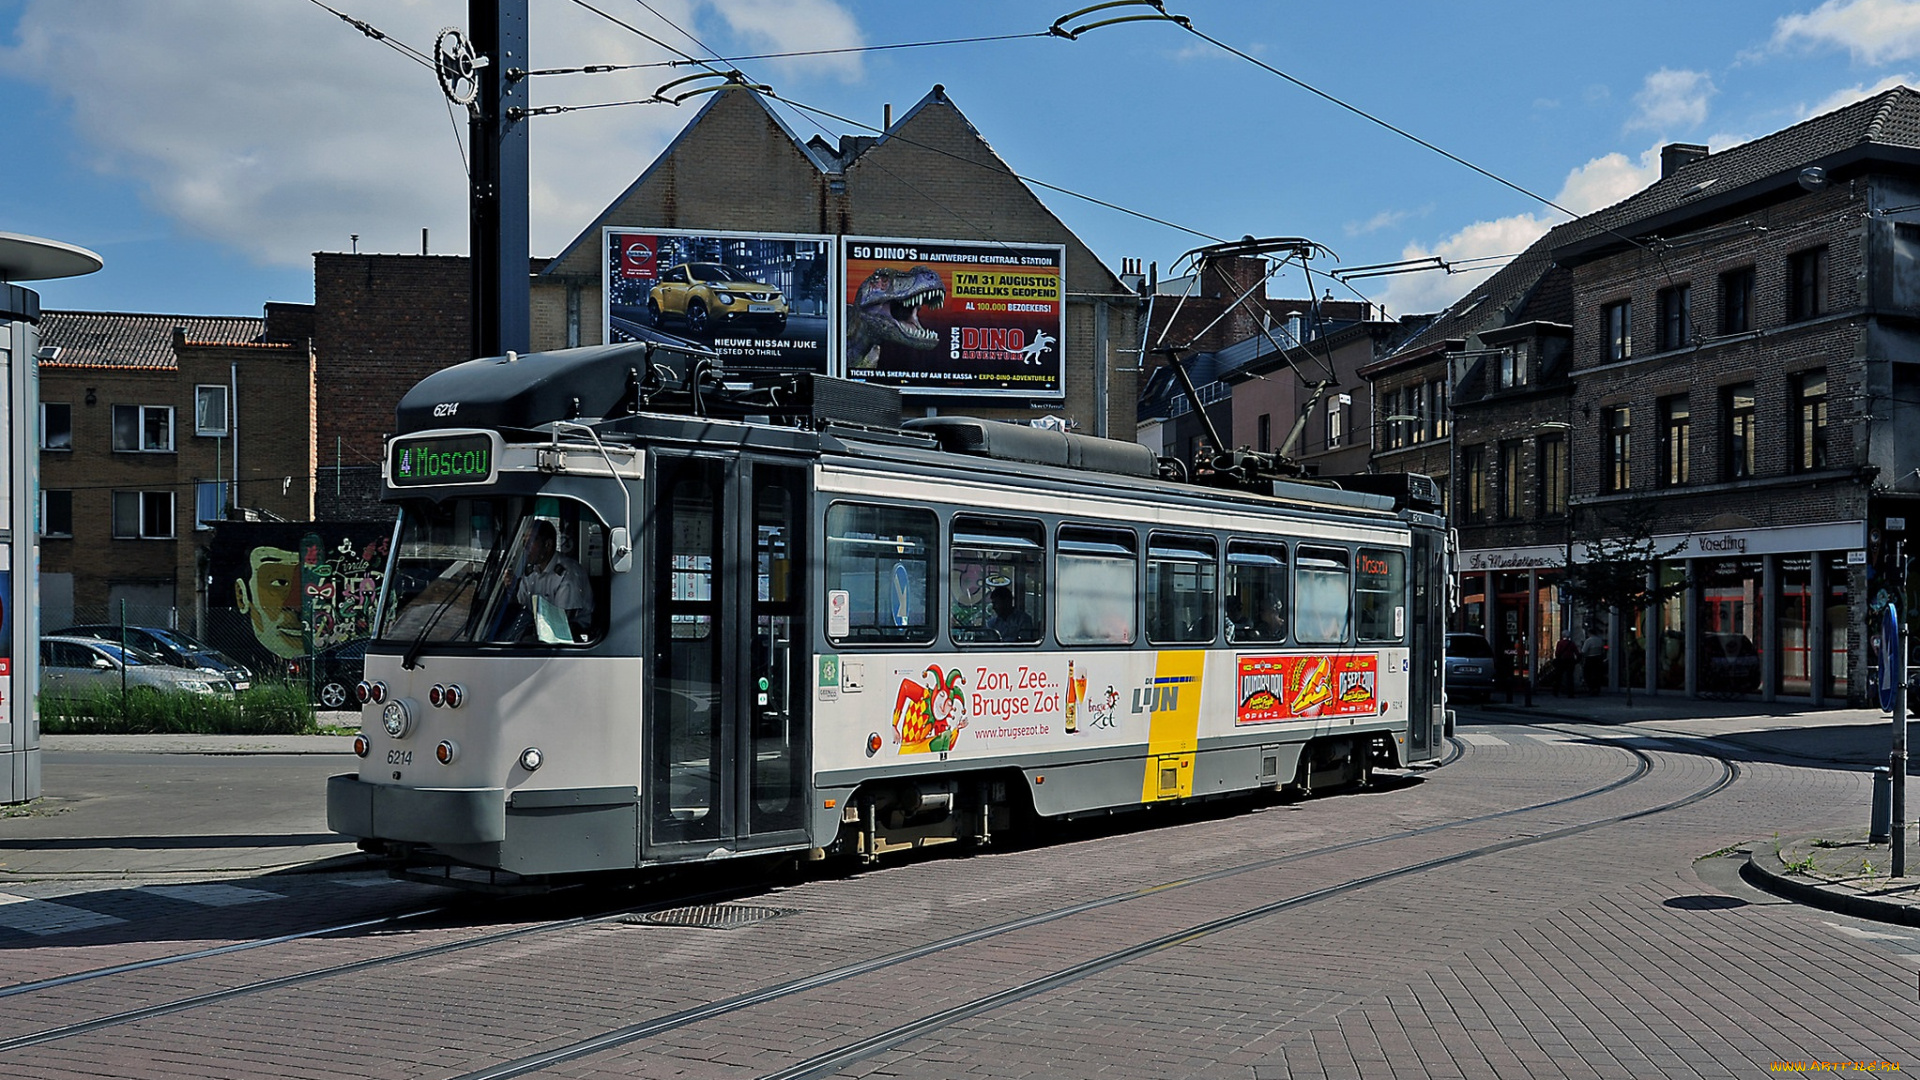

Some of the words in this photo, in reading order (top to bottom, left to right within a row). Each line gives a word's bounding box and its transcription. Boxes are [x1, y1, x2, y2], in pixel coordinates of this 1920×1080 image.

[854, 246, 871, 258] 50
[874, 247, 918, 260] DINO'S
[920, 253, 929, 261] IN
[930, 253, 978, 263] ANTWERPEN
[980, 255, 1019, 264] CENTRAAL
[1021, 257, 1052, 265] STATION
[956, 274, 978, 285] T/M
[982, 275, 995, 285] 31
[999, 276, 1056, 287] AUGUSTUS
[956, 286, 1009, 296] DAGELIJKS
[1012, 288, 1057, 298] GEOPEND
[965, 302, 975, 310] AL
[977, 303, 1006, 311] 100.000
[1007, 303, 1052, 313] BEZOEKERS!
[714, 338, 752, 347] NIEUWE
[754, 339, 790, 348] NISSAN
[793, 340, 817, 349] JUKE
[950, 327, 960, 359] EXPO
[962, 327, 1024, 351] DINO
[744, 348, 755, 356] TO
[962, 351, 1024, 360] ADVENTURE
[850, 369, 875, 377] TICKETS
[920, 371, 928, 379] OF
[943, 372, 951, 380] DE
[979, 373, 1056, 382] EXPO-DINO-ADVENTURE.BE
[434, 403, 459, 417] 6214
[400, 449, 411, 474] 4
[416, 447, 487, 476] Moscou
[1698, 535, 1745, 553] Voeding
[976, 667, 1013, 692] Zon,
[1018, 666, 1059, 689] Zee...
[1145, 677, 1153, 685] DE
[972, 693, 1029, 721] Brugse
[1033, 690, 1060, 713] Zot
[1131, 686, 1179, 714] LIJN
[1090, 711, 1117, 730] Zot
[975, 724, 1050, 740] www.brugsezot.be
[387, 749, 412, 766] 6214
